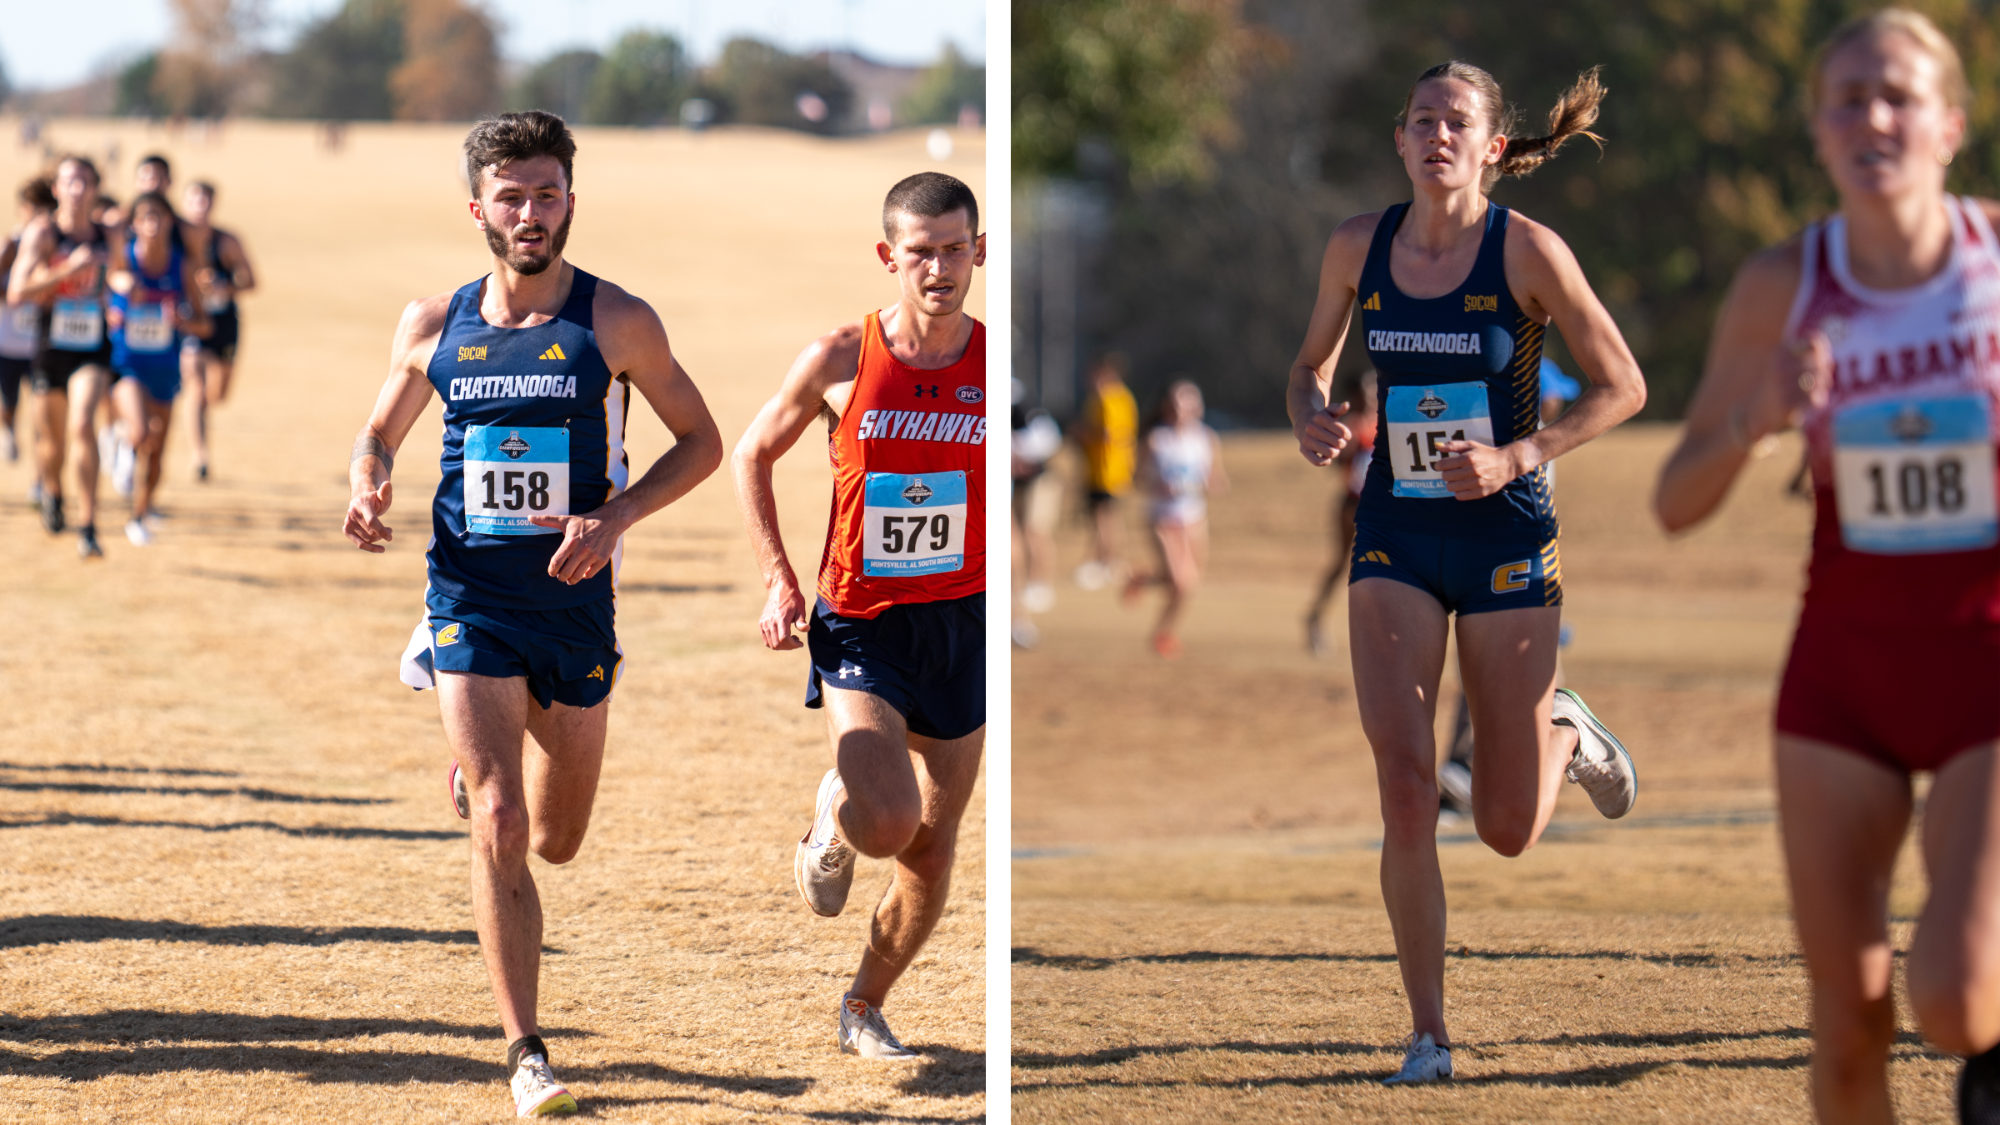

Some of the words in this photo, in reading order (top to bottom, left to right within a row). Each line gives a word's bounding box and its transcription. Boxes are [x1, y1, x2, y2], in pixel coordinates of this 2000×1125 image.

[1464, 294, 1498, 312] SOCON
[457, 345, 488, 362] SOCON
[1368, 330, 1481, 354] CHATTANOOGA
[450, 375, 577, 401] CHATTANOOGA
[961, 391, 978, 399] OVC
[857, 409, 986, 446] SKYHAWKS
[1406, 429, 1466, 472] 15
[481, 470, 550, 511] 158
[1866, 457, 1965, 517] 108
[471, 517, 507, 527] HUNTSVILLE,
[882, 514, 950, 554] 579
[870, 560, 909, 569] HUNTSVILLE,
[918, 559, 937, 568] SOUTH
[936, 556, 958, 565] REGION
[1491, 559, 1532, 594] C
